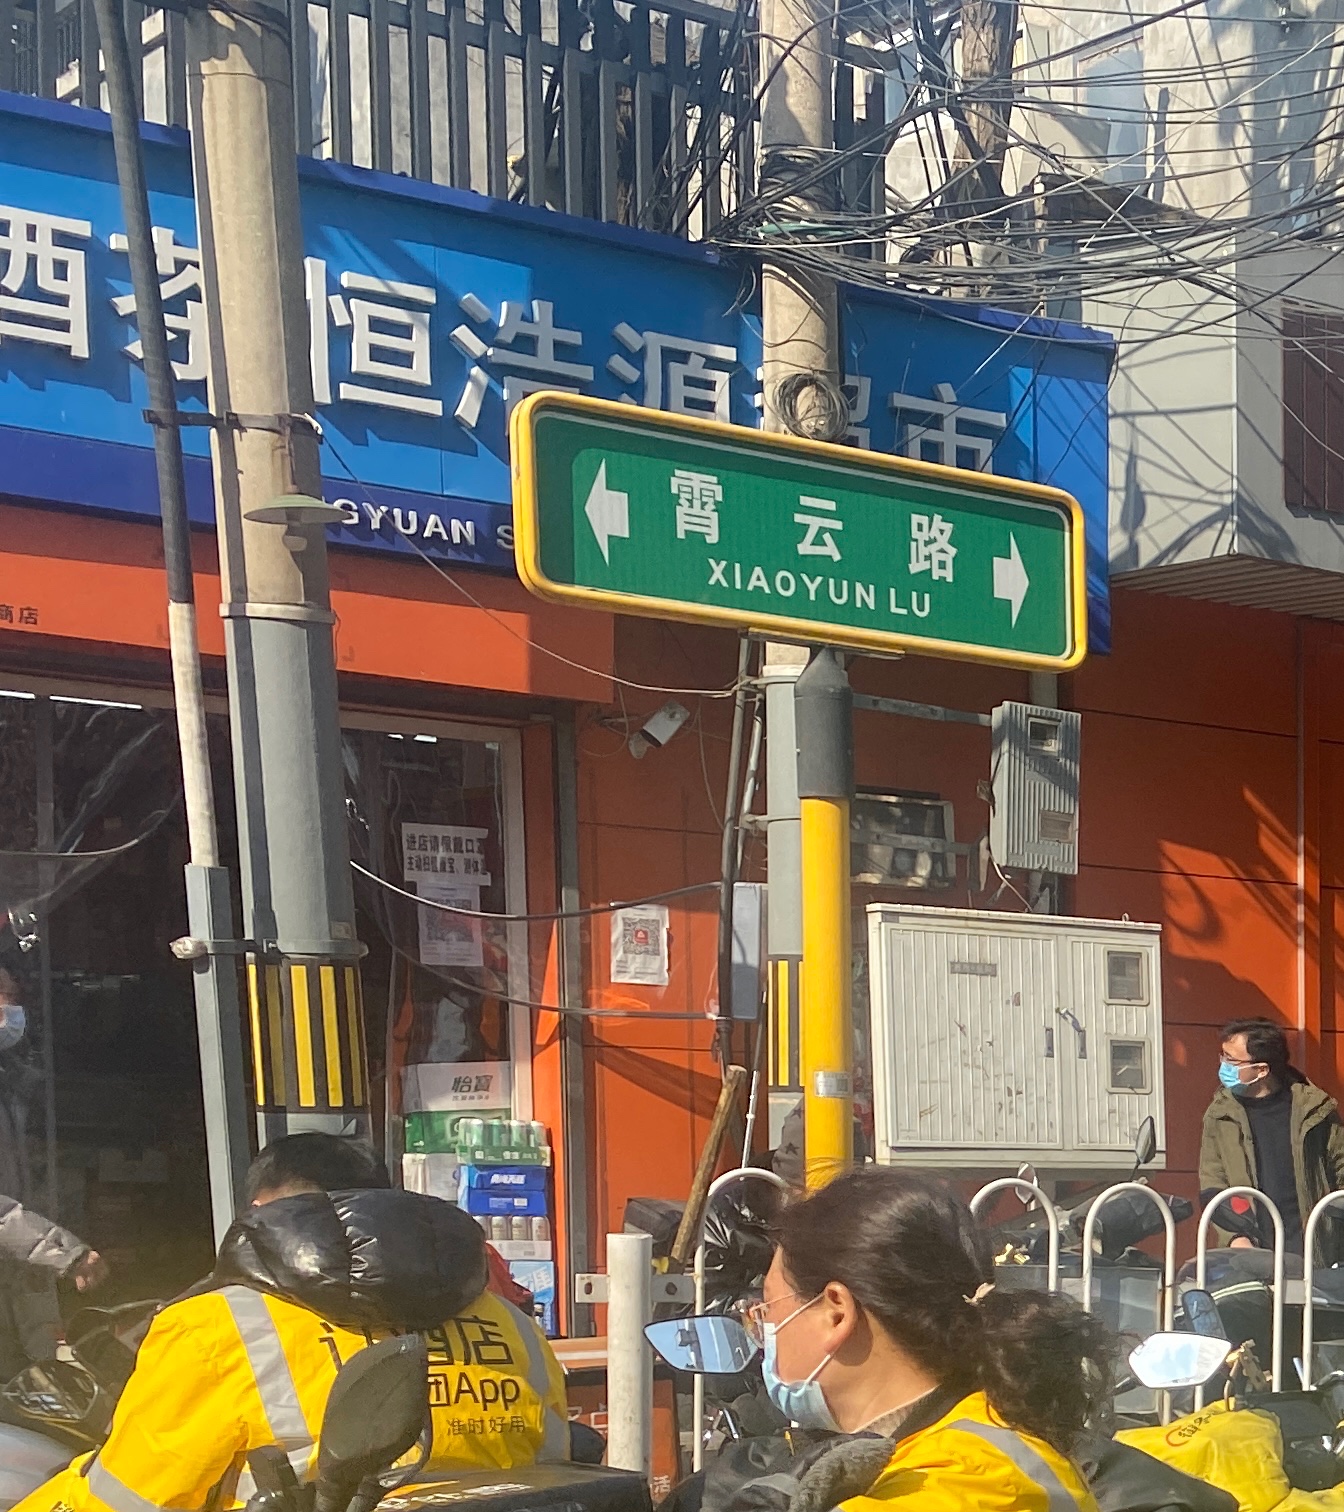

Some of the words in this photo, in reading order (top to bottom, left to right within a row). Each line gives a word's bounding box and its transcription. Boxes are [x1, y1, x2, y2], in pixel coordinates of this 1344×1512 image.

[669, 469, 960, 584] 霄云路
[707, 557, 877, 612] XIAOYUN
[887, 585, 932, 620] LU
[446, 1415, 526, 1436] 准时好用
